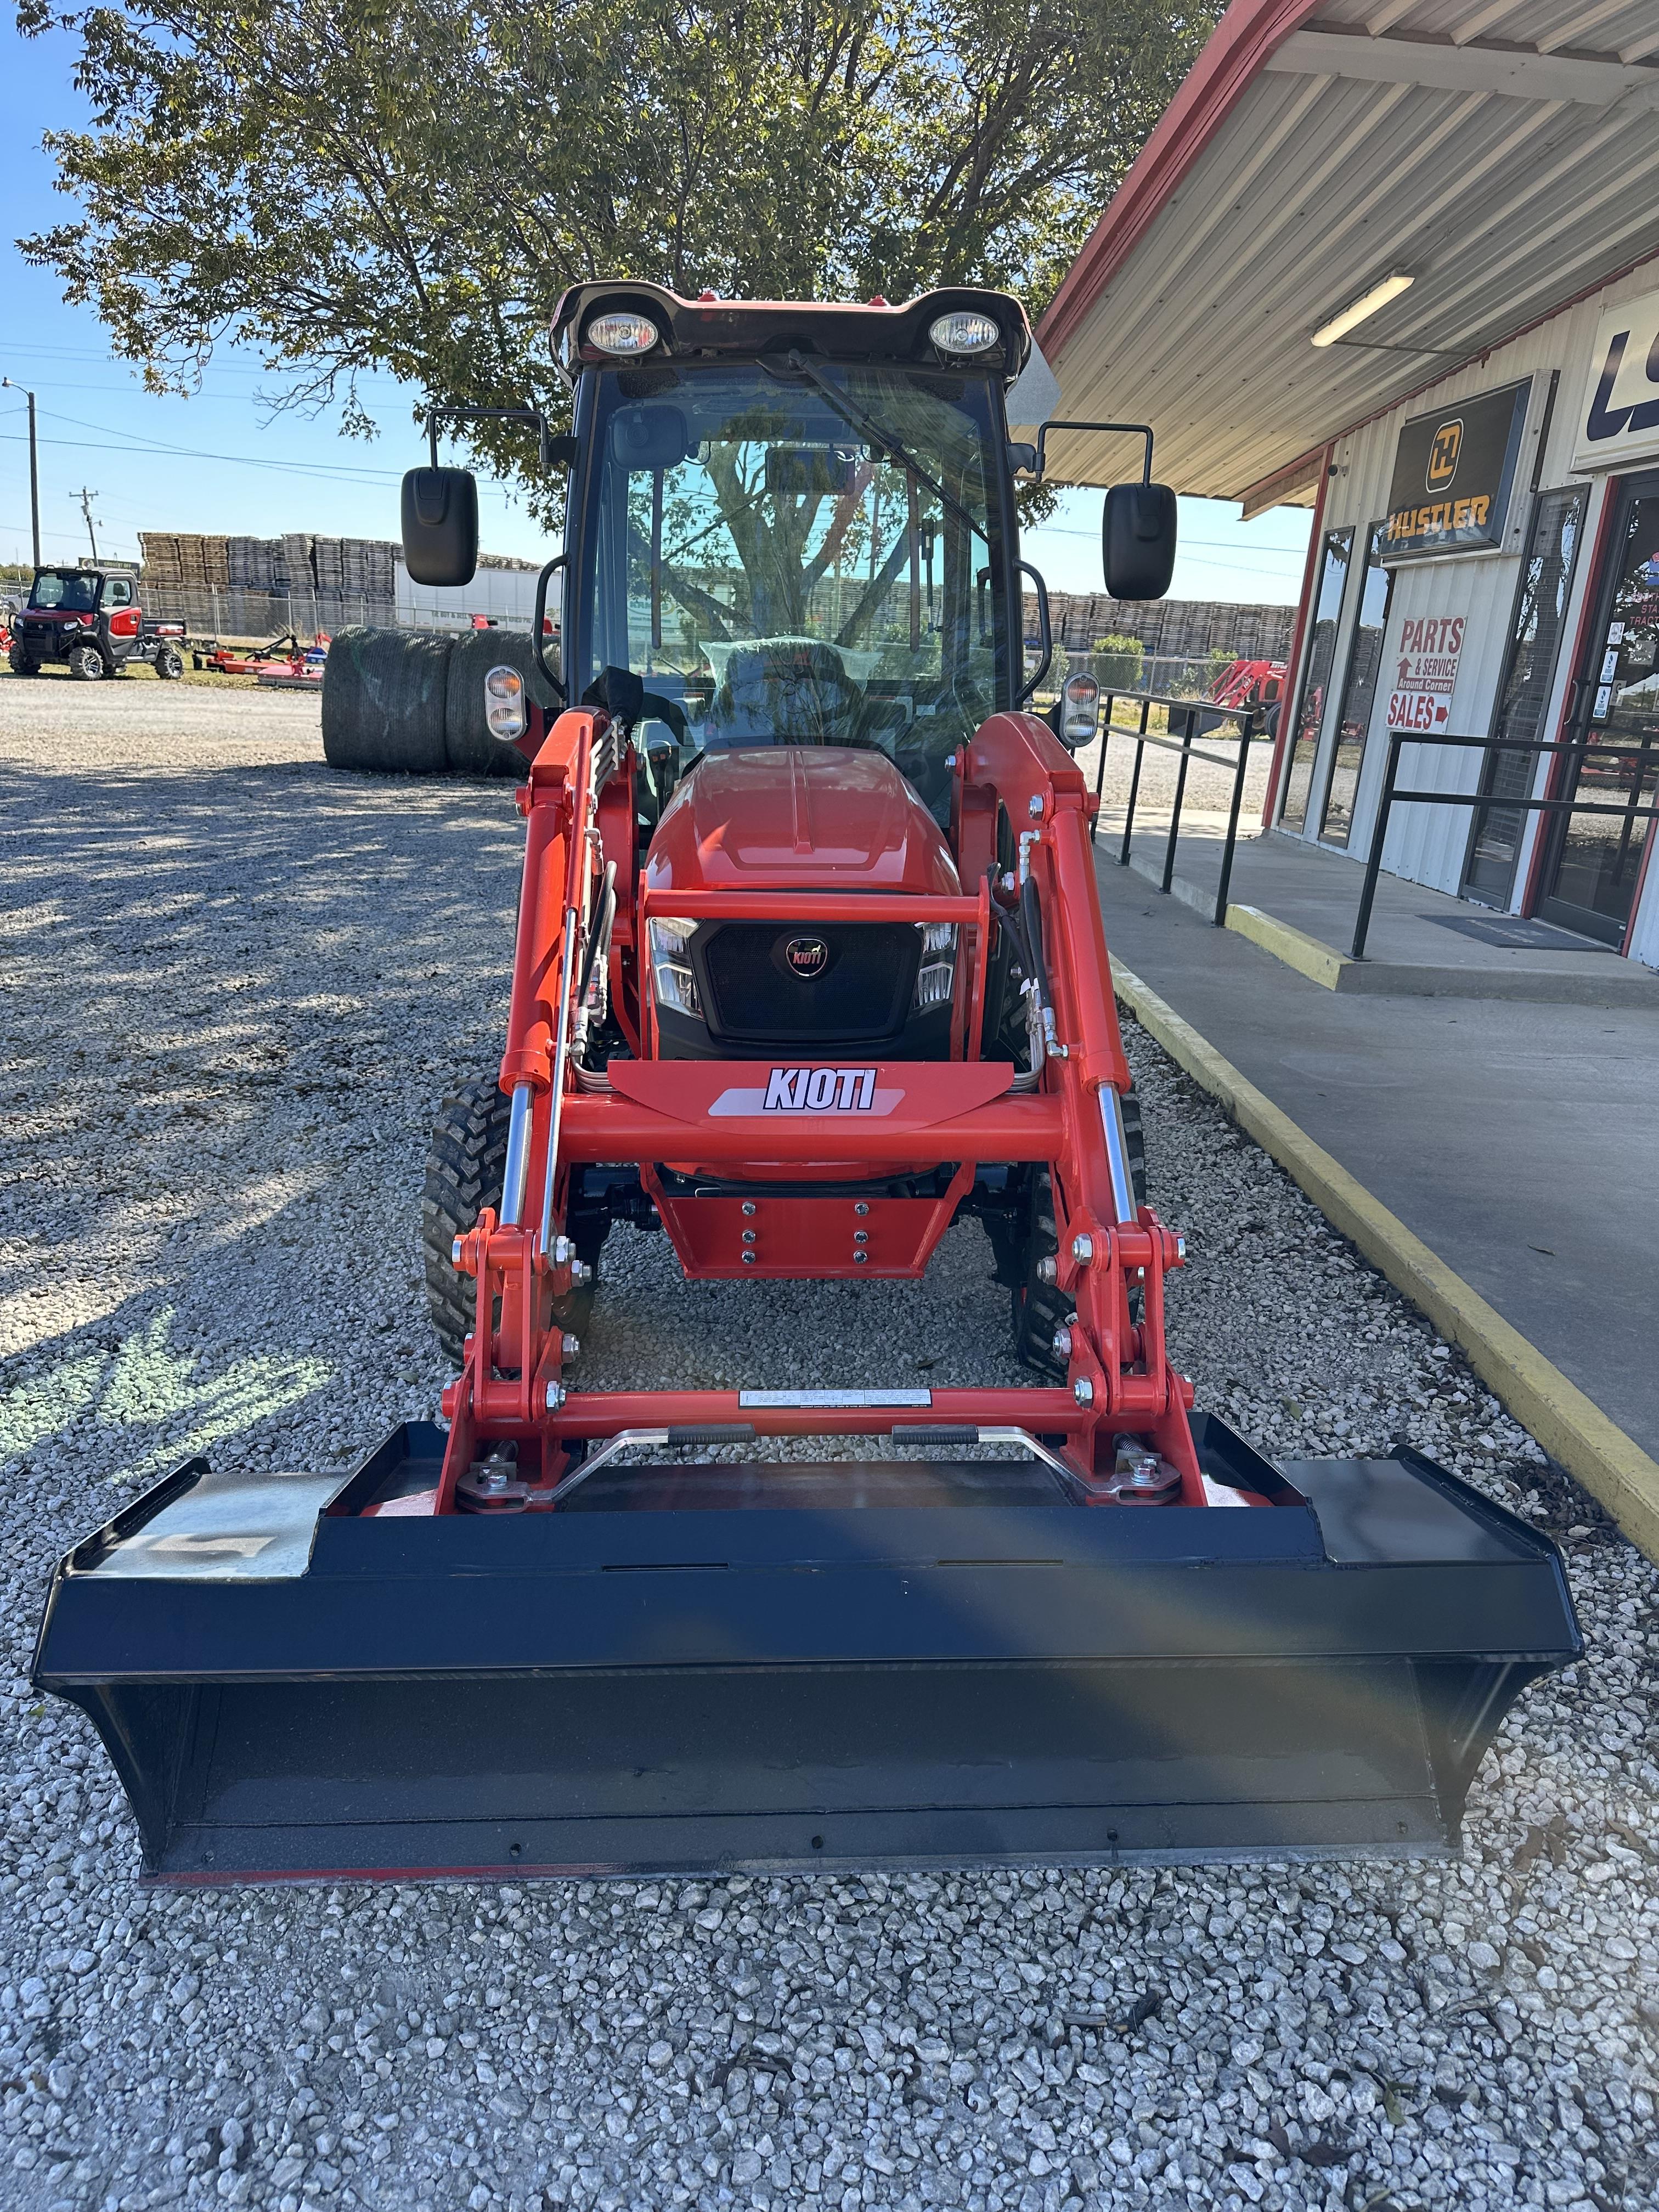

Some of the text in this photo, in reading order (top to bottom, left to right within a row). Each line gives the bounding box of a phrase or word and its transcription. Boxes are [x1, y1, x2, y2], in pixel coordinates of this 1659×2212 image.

[1387, 495, 1490, 541] HUSTLER
[1400, 617, 1464, 654] PARTS
[1398, 678, 1452, 692] Around Corner
[1415, 658, 1457, 676] & SERVICE
[1387, 693, 1435, 730] SALES
[793, 952, 822, 964] KIOTI
[763, 1067, 878, 1110] KIOTI
